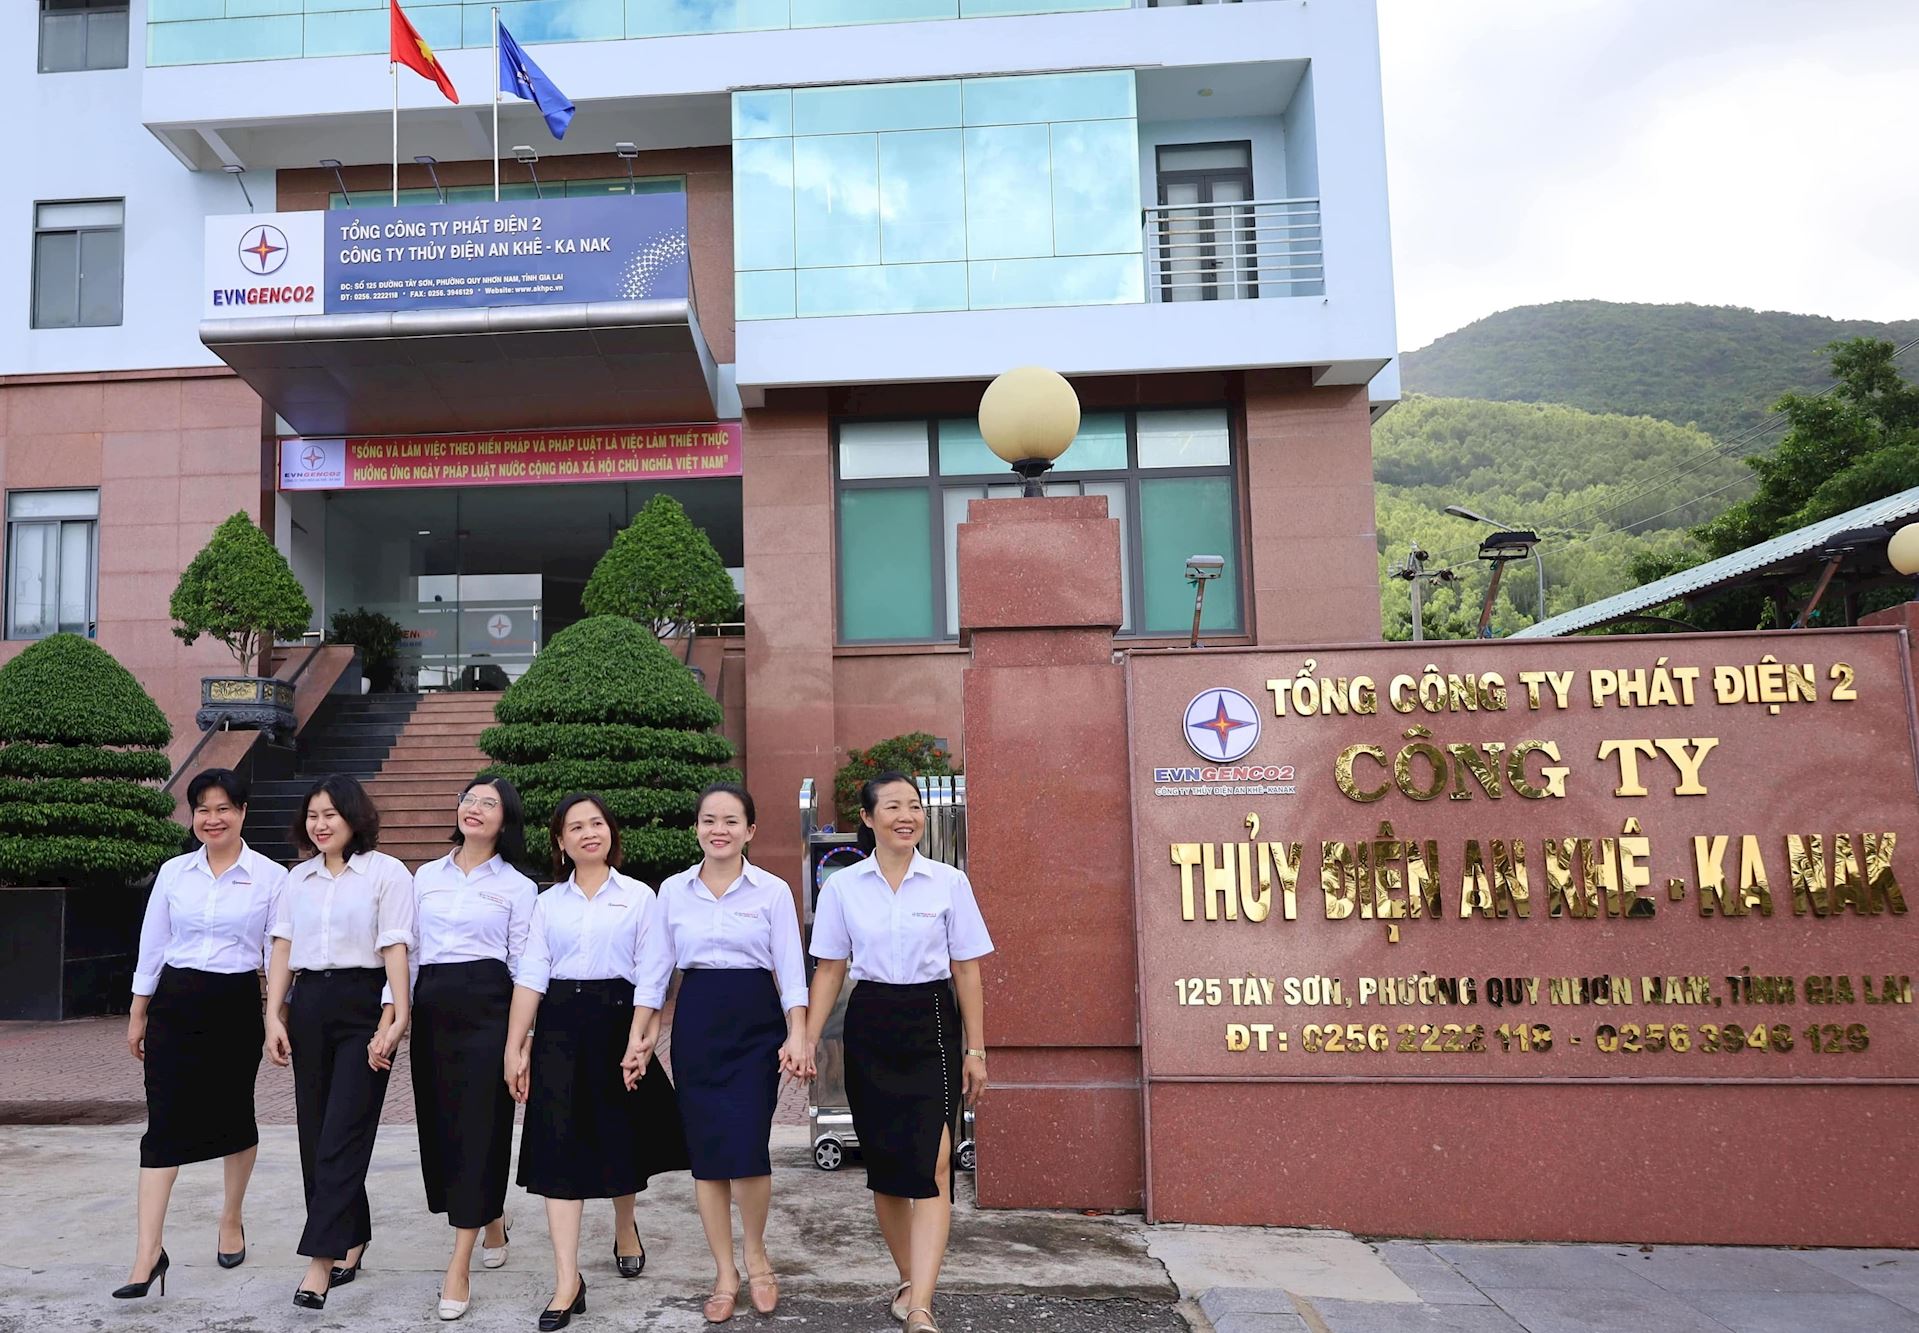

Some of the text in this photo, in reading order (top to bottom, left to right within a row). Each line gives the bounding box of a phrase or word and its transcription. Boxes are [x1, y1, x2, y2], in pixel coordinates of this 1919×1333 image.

[340, 214, 542, 240] TỔNG CÔNG TY PHÁT ĐIỆN 2
[340, 246, 382, 264] CÔNG
[386, 247, 404, 262] TY
[408, 241, 446, 260] THỦY
[450, 240, 484, 261] ĐIỆN
[488, 242, 509, 257] AN
[513, 237, 543, 255] KHÊ
[555, 239, 576, 254] KA
[580, 237, 611, 252] NAK
[213, 286, 315, 306] EVNGENCO2
[354, 280, 365, 290] SỐ
[418, 279, 435, 288] SƠN,
[467, 277, 482, 285] QUY
[482, 275, 502, 284] NHƠN
[504, 275, 521, 283] NAM,
[410, 290, 426, 298] FAX:
[485, 286, 514, 294] Website:
[385, 442, 399, 458] VÀ
[401, 440, 421, 457] LÀM
[424, 440, 446, 460] VIỆC
[449, 441, 475, 456] THEO
[477, 437, 501, 455] HIẾN
[504, 437, 530, 453] PHÁP
[548, 435, 575, 452] PHÁP
[577, 434, 602, 454] LUẬT
[605, 433, 618, 450] LÀ
[620, 433, 644, 453] VIỆC
[646, 432, 667, 448] LÀM
[669, 428, 699, 447] THIẾT
[701, 430, 729, 449] THỰC
[390, 464, 411, 480] ỨNG
[413, 463, 441, 479] NGÀY
[443, 462, 469, 478] PHÁP
[471, 462, 496, 481] LUẬT
[499, 460, 527, 477] NƯỚC
[528, 461, 556, 479] CỘNG
[559, 458, 580, 474] HÒA
[598, 457, 616, 477] HỘI
[618, 453, 639, 472] CHỦ
[641, 453, 673, 471] NGHĨA
[676, 453, 699, 473] VIỆT
[1266, 654, 1857, 717] TỔNG CÔNG TY PHÁT ĐIỆN 2
[1154, 765, 1295, 783] EVNGENCO2
[1334, 723, 1720, 802] CÔNG TY
[1155, 786, 1178, 796] CÔNG
[1179, 787, 1191, 796] TY
[1213, 785, 1234, 797] ĐIỆN
[1234, 786, 1247, 795] AN
[1170, 811, 1303, 923] THỦY
[1321, 820, 1443, 943] ĐIỆN
[1460, 839, 1532, 919] AN
[1543, 816, 1656, 919] KHÊ
[1694, 834, 1774, 917] KA
[1786, 832, 1909, 916] NAK
[1174, 978, 1223, 1006] 125
[1283, 975, 1353, 1009] SƠN,
[1359, 970, 1477, 1006] PHƯỜNG
[1486, 977, 1541, 1008] QUY
[1549, 974, 1633, 1006] NHƠN
[1641, 975, 1722, 1008] NAM,
[1725, 966, 1796, 1005] TỈNH
[1804, 975, 1856, 1005] GIA
[1862, 975, 1913, 1005] LAI
[1225, 1023, 1288, 1052] ĐT:
[1301, 1023, 1389, 1053] 0256
[1395, 1023, 1487, 1053] 2222
[1494, 1023, 1553, 1053] 118
[1568, 1033, 1584, 1044] -
[1595, 1023, 1691, 1053] 0256
[1803, 1023, 1870, 1053] 129
